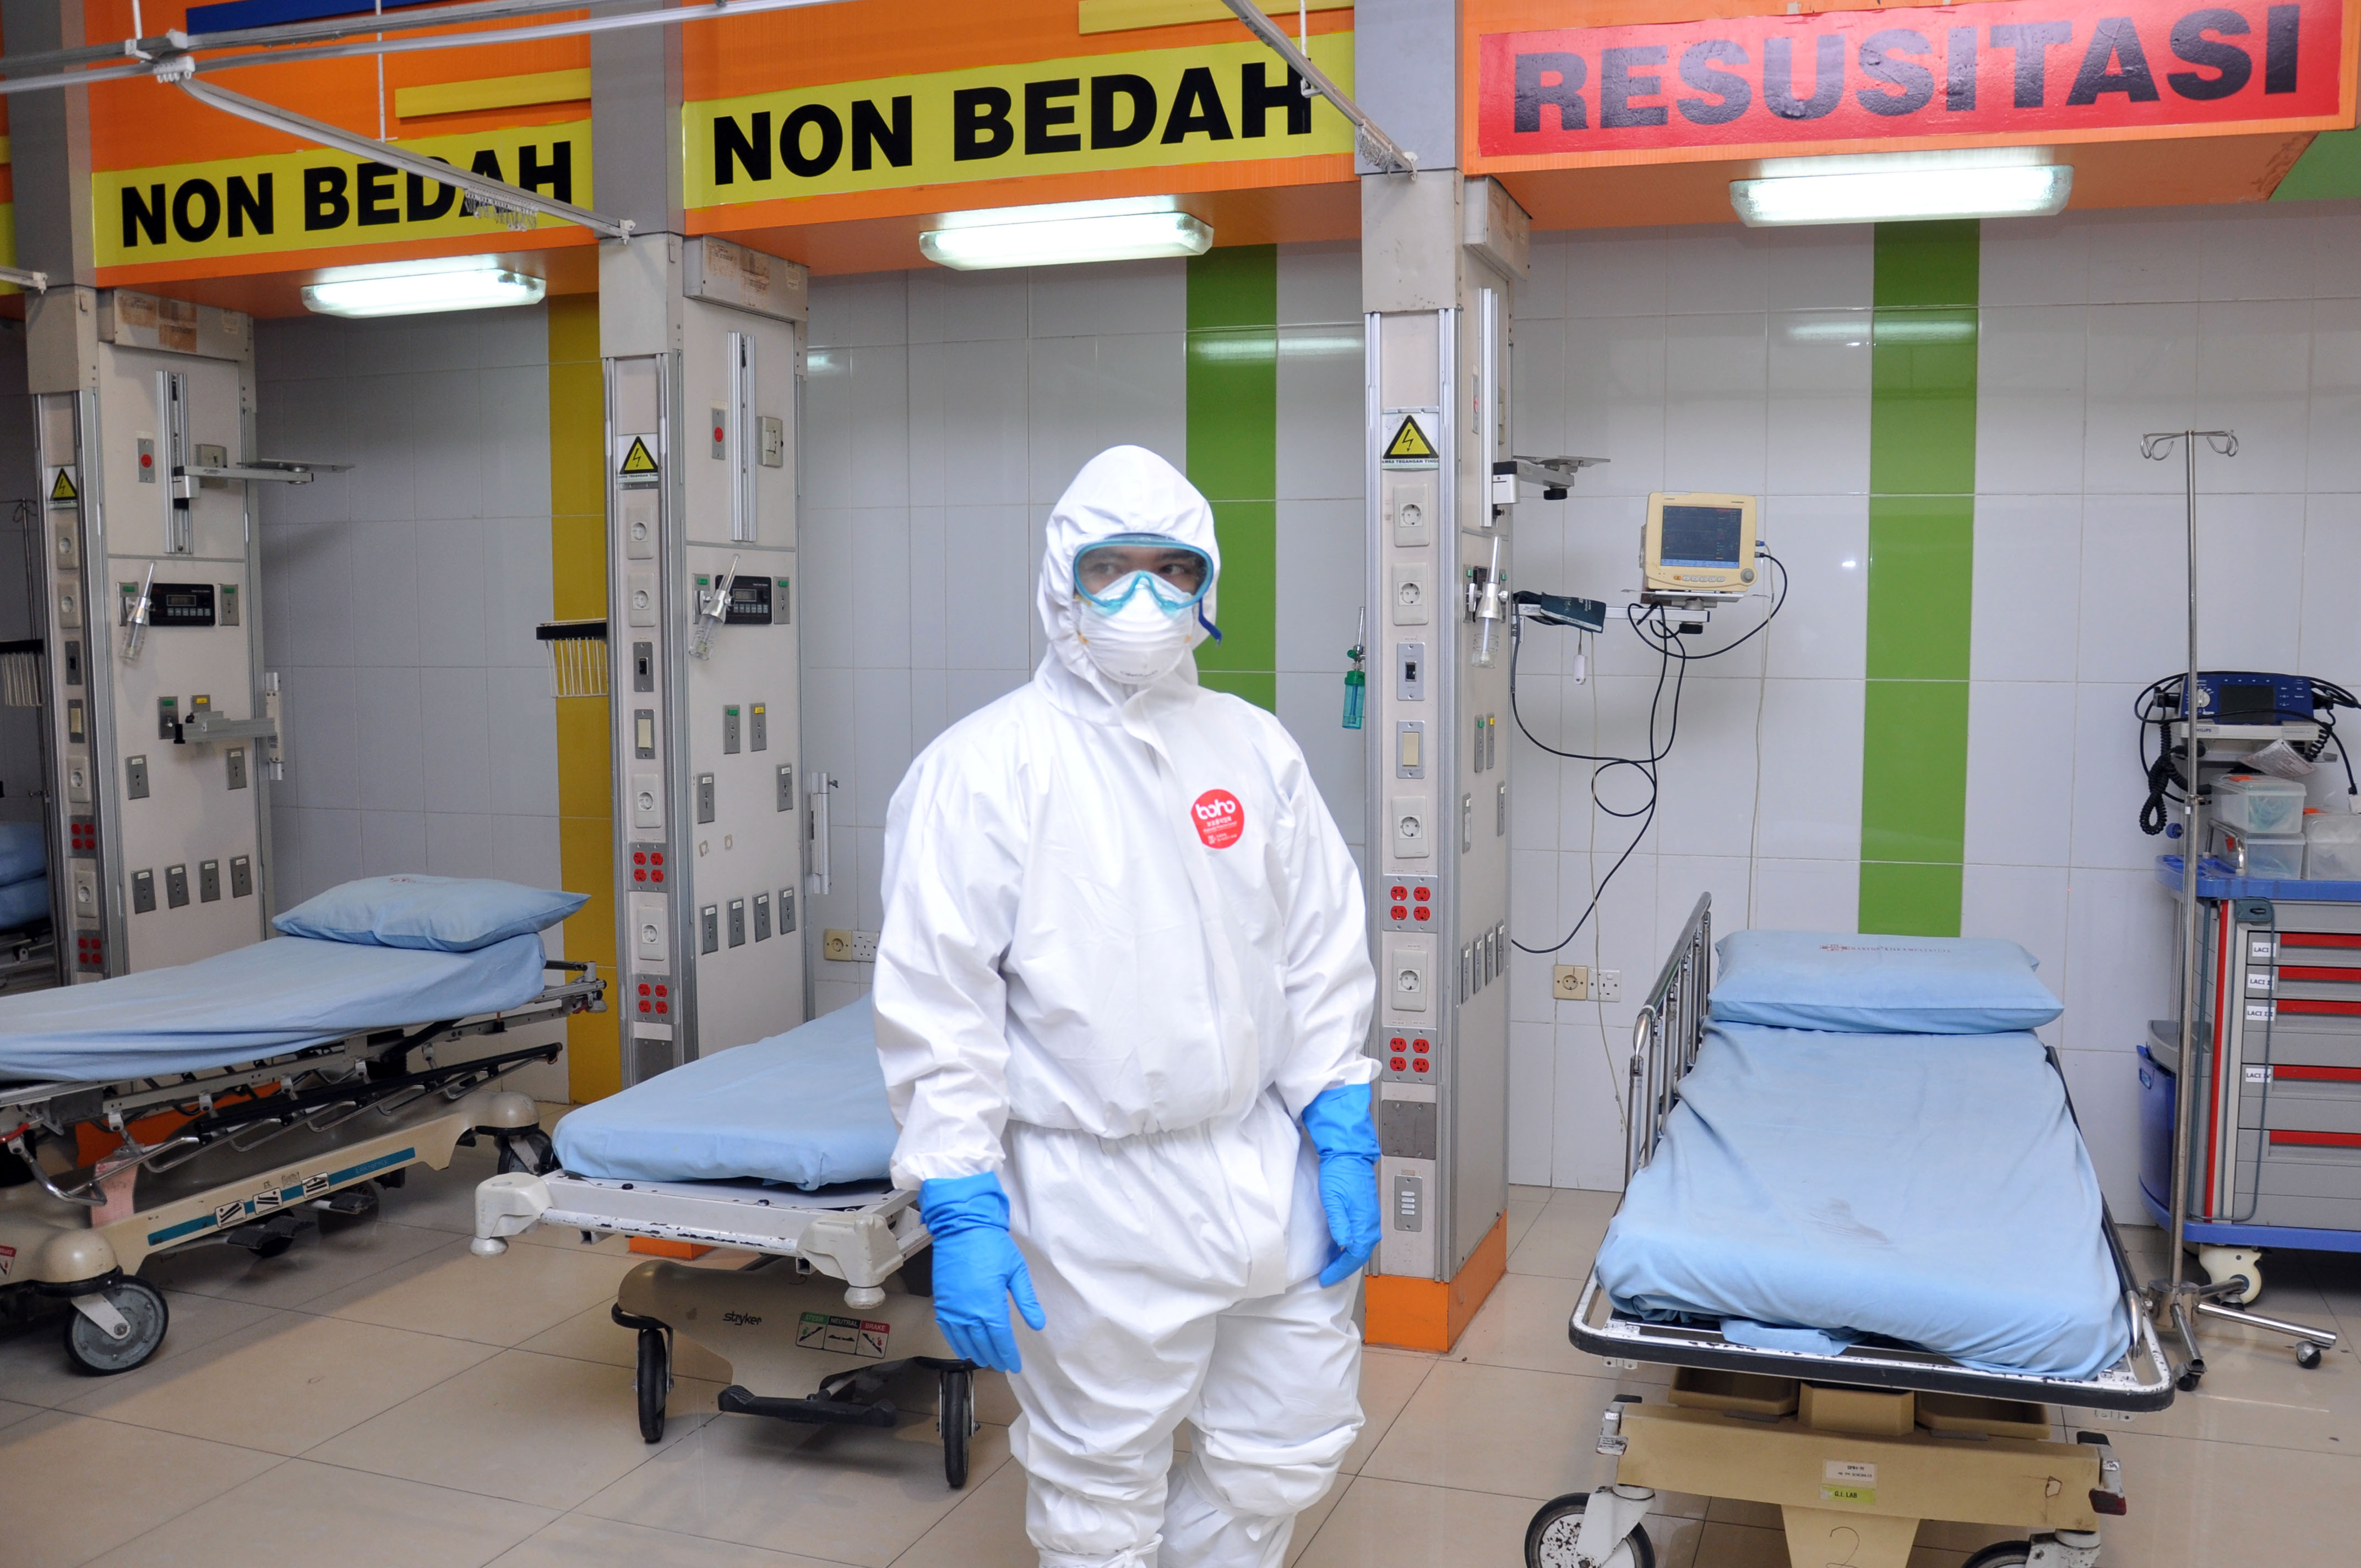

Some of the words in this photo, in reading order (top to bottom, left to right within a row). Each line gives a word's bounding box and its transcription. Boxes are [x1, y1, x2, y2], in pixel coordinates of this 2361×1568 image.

[1514, 3, 2300, 134] RESUSITASI
[714, 95, 912, 186] NON
[954, 58, 1313, 162] BEDAH
[121, 173, 274, 248] NON
[722, 1311, 762, 1326] stryker
[804, 1314, 824, 1322] STEER
[830, 1317, 858, 1327] NEUTRAL
[865, 1322, 886, 1331] BRAKE
